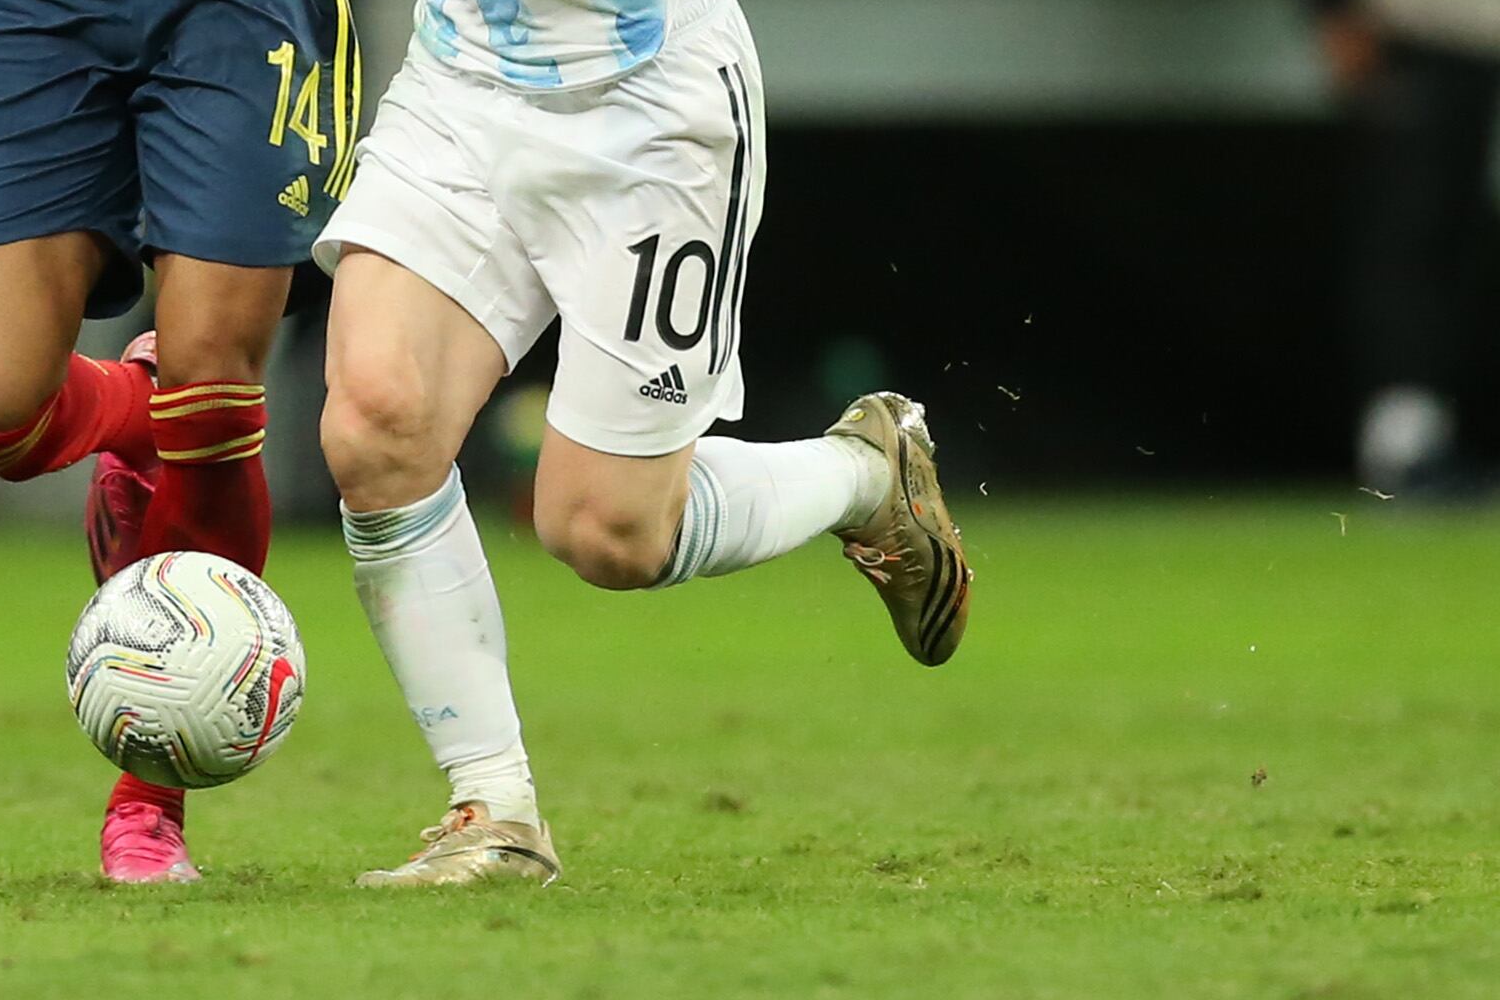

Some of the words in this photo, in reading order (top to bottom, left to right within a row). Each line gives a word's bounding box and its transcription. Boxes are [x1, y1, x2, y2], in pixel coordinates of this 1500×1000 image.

[267, 41, 327, 164] 14
[624, 233, 716, 351] 10
[640, 384, 687, 404] adidas
